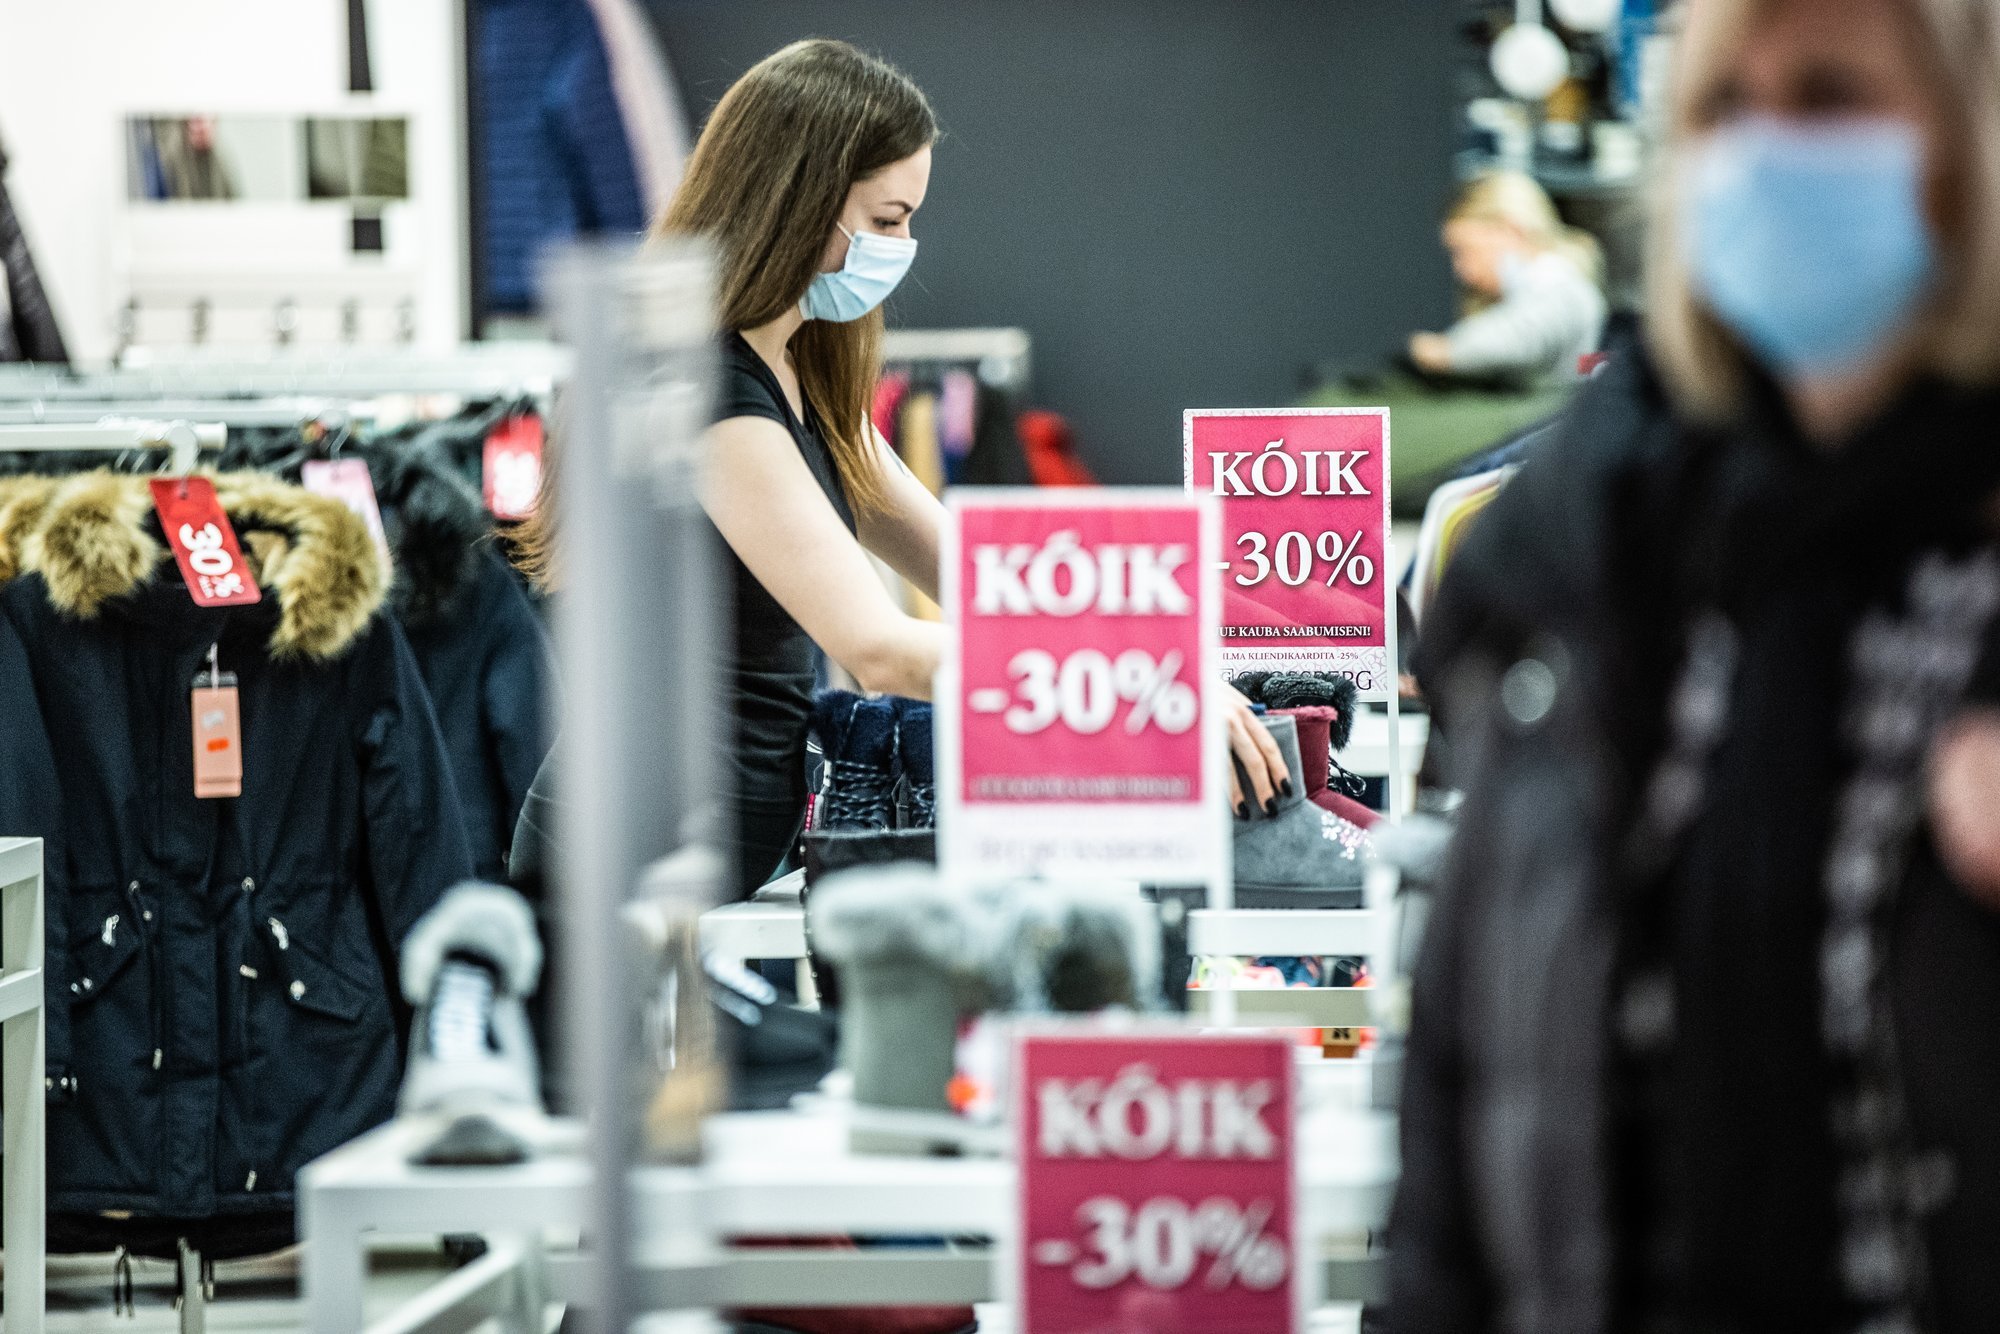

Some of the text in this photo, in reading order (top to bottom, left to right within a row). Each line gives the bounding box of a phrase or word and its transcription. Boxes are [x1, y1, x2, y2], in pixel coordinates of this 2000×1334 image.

[1207, 438, 1371, 497] KÕIK
[973, 530, 1189, 617] KÕIK
[1215, 529, 1374, 588] -30%
[1218, 625, 1371, 638] UE KAUBA SAABUMISENI!
[1222, 651, 1359, 661] ILMA KLIENDIKAARDITA -25%
[968, 648, 1198, 736] -30%
[1032, 1195, 1288, 1292] -30%
